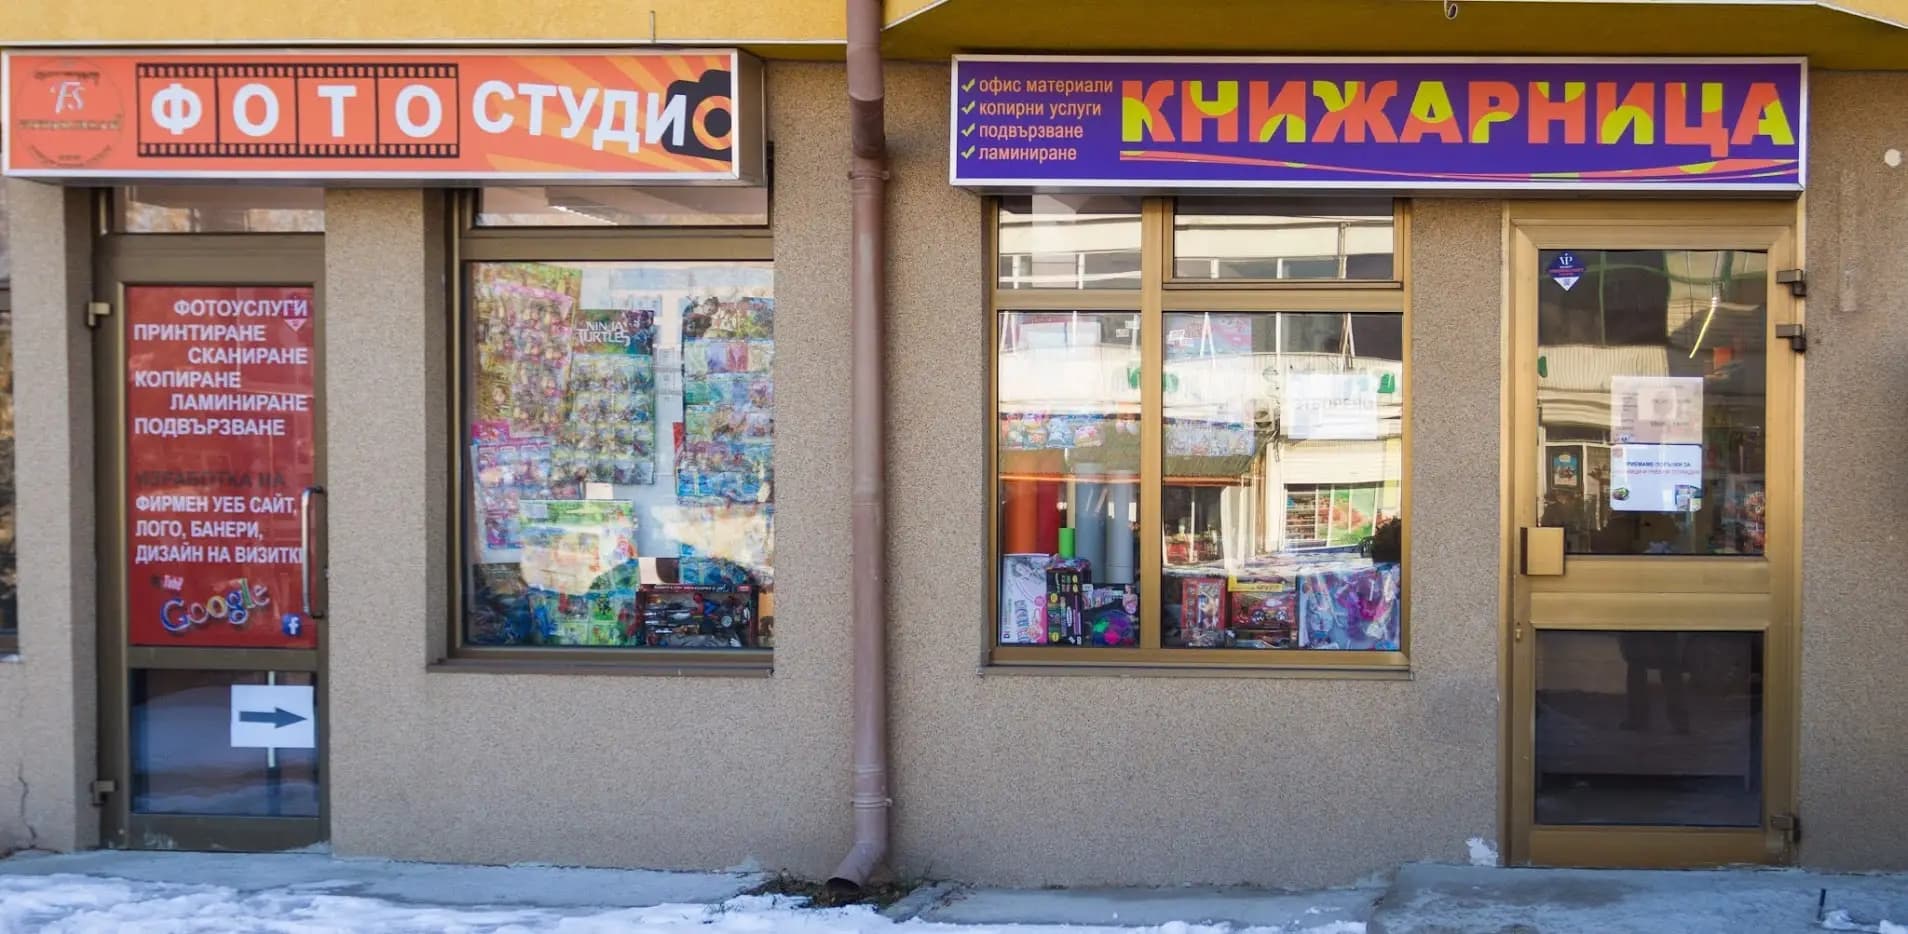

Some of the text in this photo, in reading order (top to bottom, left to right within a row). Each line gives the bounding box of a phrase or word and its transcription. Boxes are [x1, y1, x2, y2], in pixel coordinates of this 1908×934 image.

[979, 76, 1113, 96] офис материали
[151, 83, 442, 138] ФОТО
[979, 102, 1102, 119] копирни услуги
[1122, 80, 1796, 157] КНИЖАРНИЦА
[979, 124, 1083, 142] подвързване
[978, 147, 1077, 164] ламиниране
[174, 299, 307, 317] ФОТОУСЛУГИ
[134, 324, 266, 341] ПРИНТИРАНЕ
[585, 320, 625, 331] NINJA
[576, 328, 630, 347] TURTLES
[188, 347, 308, 364] СКАНИРАНЕ
[135, 370, 241, 388] КОПИРАНЕ
[170, 393, 308, 411] ЛАМИНИРАНЕ
[134, 417, 285, 437] ПОДВЪРЗВАНЕ
[258, 471, 286, 487] НА
[135, 493, 297, 516] ФИРМЕН УЕБ САЙТ,
[135, 520, 263, 540] ЛОГО, БАНЕРИ,
[135, 541, 203, 564] ДИЗАЙН
[207, 546, 231, 563] НА
[160, 578, 270, 632] Google
